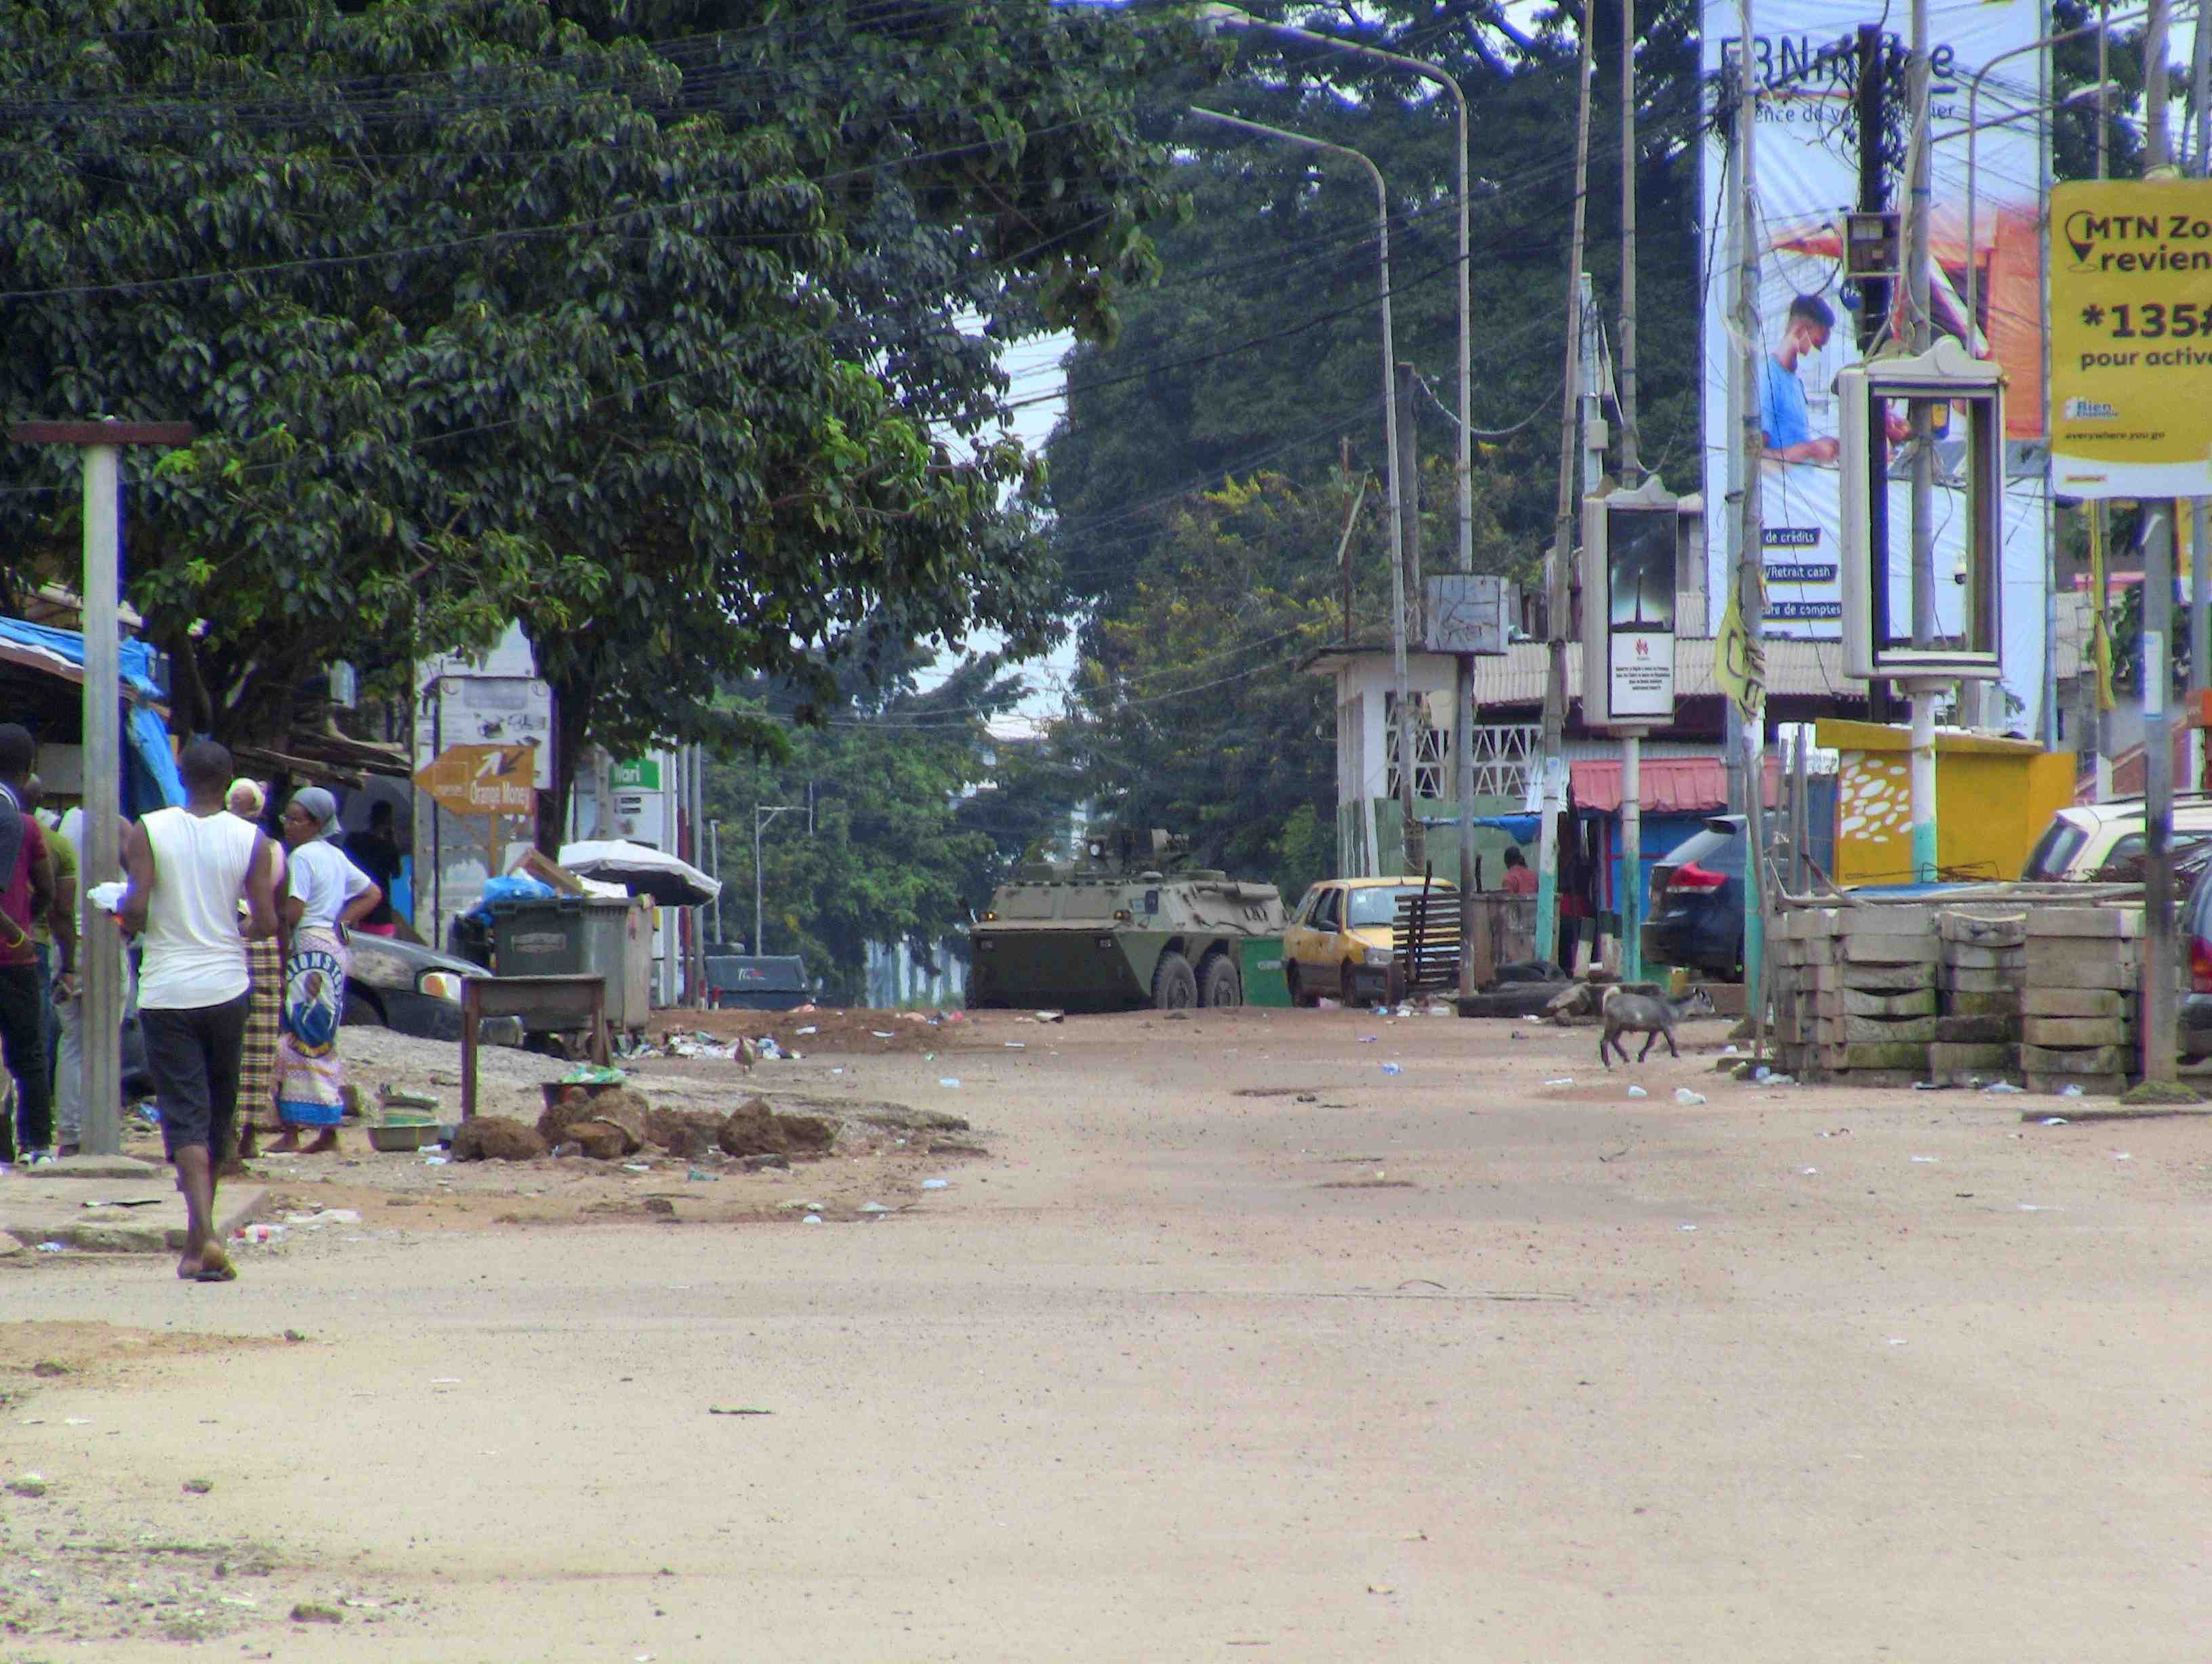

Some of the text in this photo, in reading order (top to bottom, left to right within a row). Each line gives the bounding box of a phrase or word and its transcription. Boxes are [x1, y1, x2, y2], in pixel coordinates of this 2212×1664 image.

[2085, 216, 2159, 238] MTN
[2081, 352, 2139, 371] pour
[1766, 531, 1777, 543] de
[1807, 566, 1830, 577] cash
[1784, 603, 1797, 615] de
[470, 780, 499, 806] Orange
